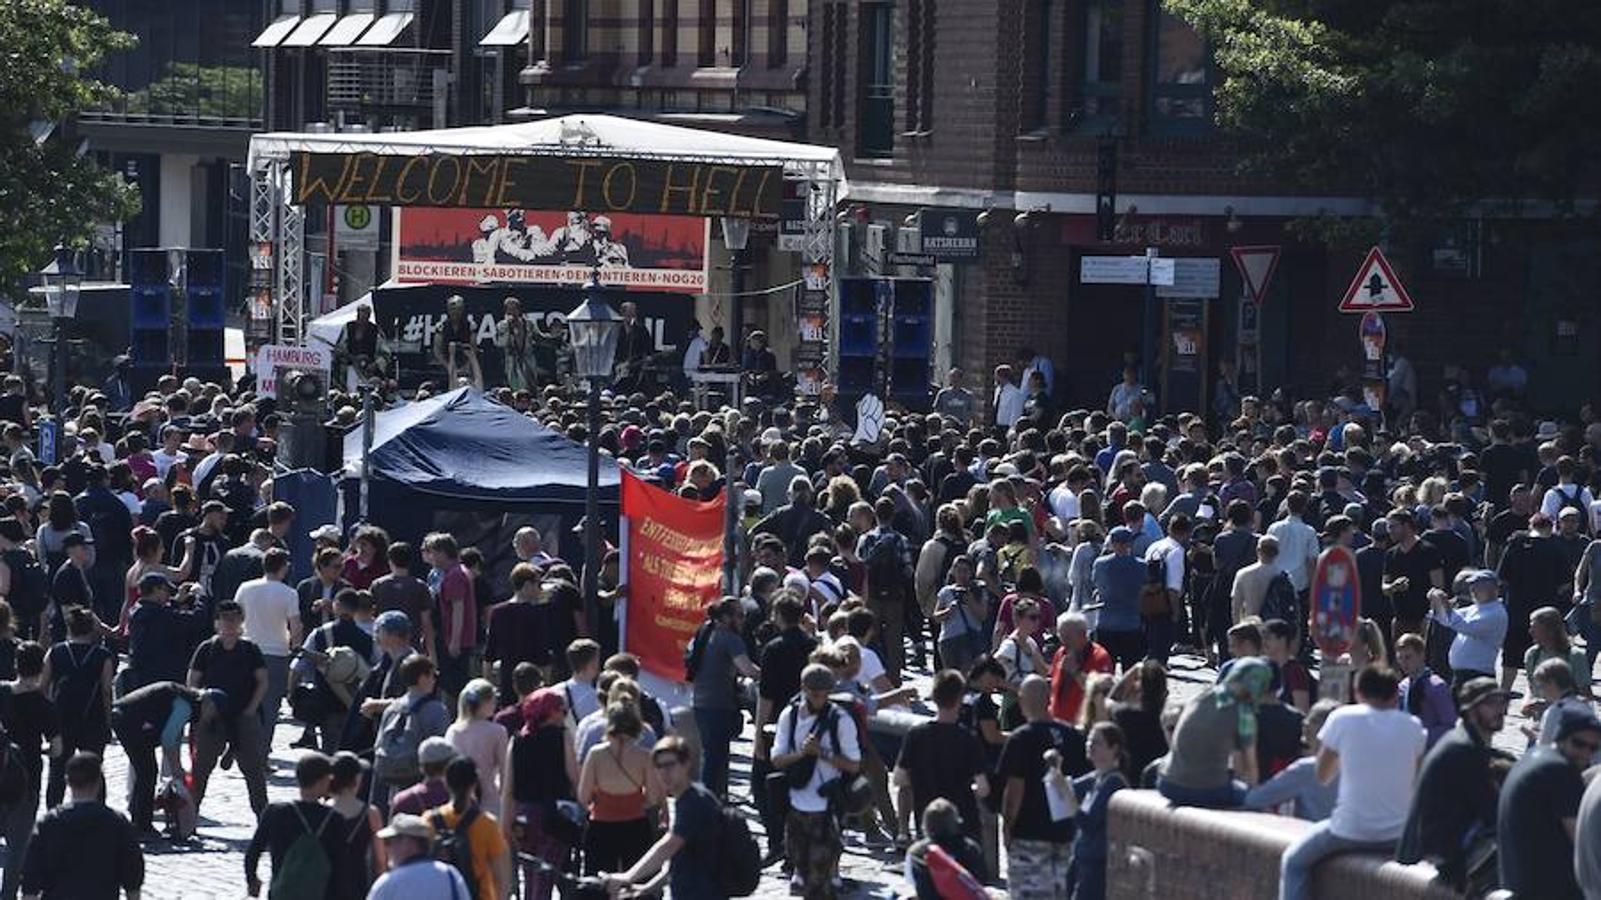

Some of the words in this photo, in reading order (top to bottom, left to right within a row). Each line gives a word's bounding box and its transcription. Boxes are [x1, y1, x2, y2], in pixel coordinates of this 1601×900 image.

[298, 153, 527, 207] WELCOME
[566, 159, 637, 211] TO
[661, 164, 780, 219] HELL
[398, 264, 478, 278] BLOCKIEREN
[483, 267, 560, 280] SABOTIEREN
[662, 274, 704, 286] NOG20
[267, 349, 321, 365] HAMBURG
